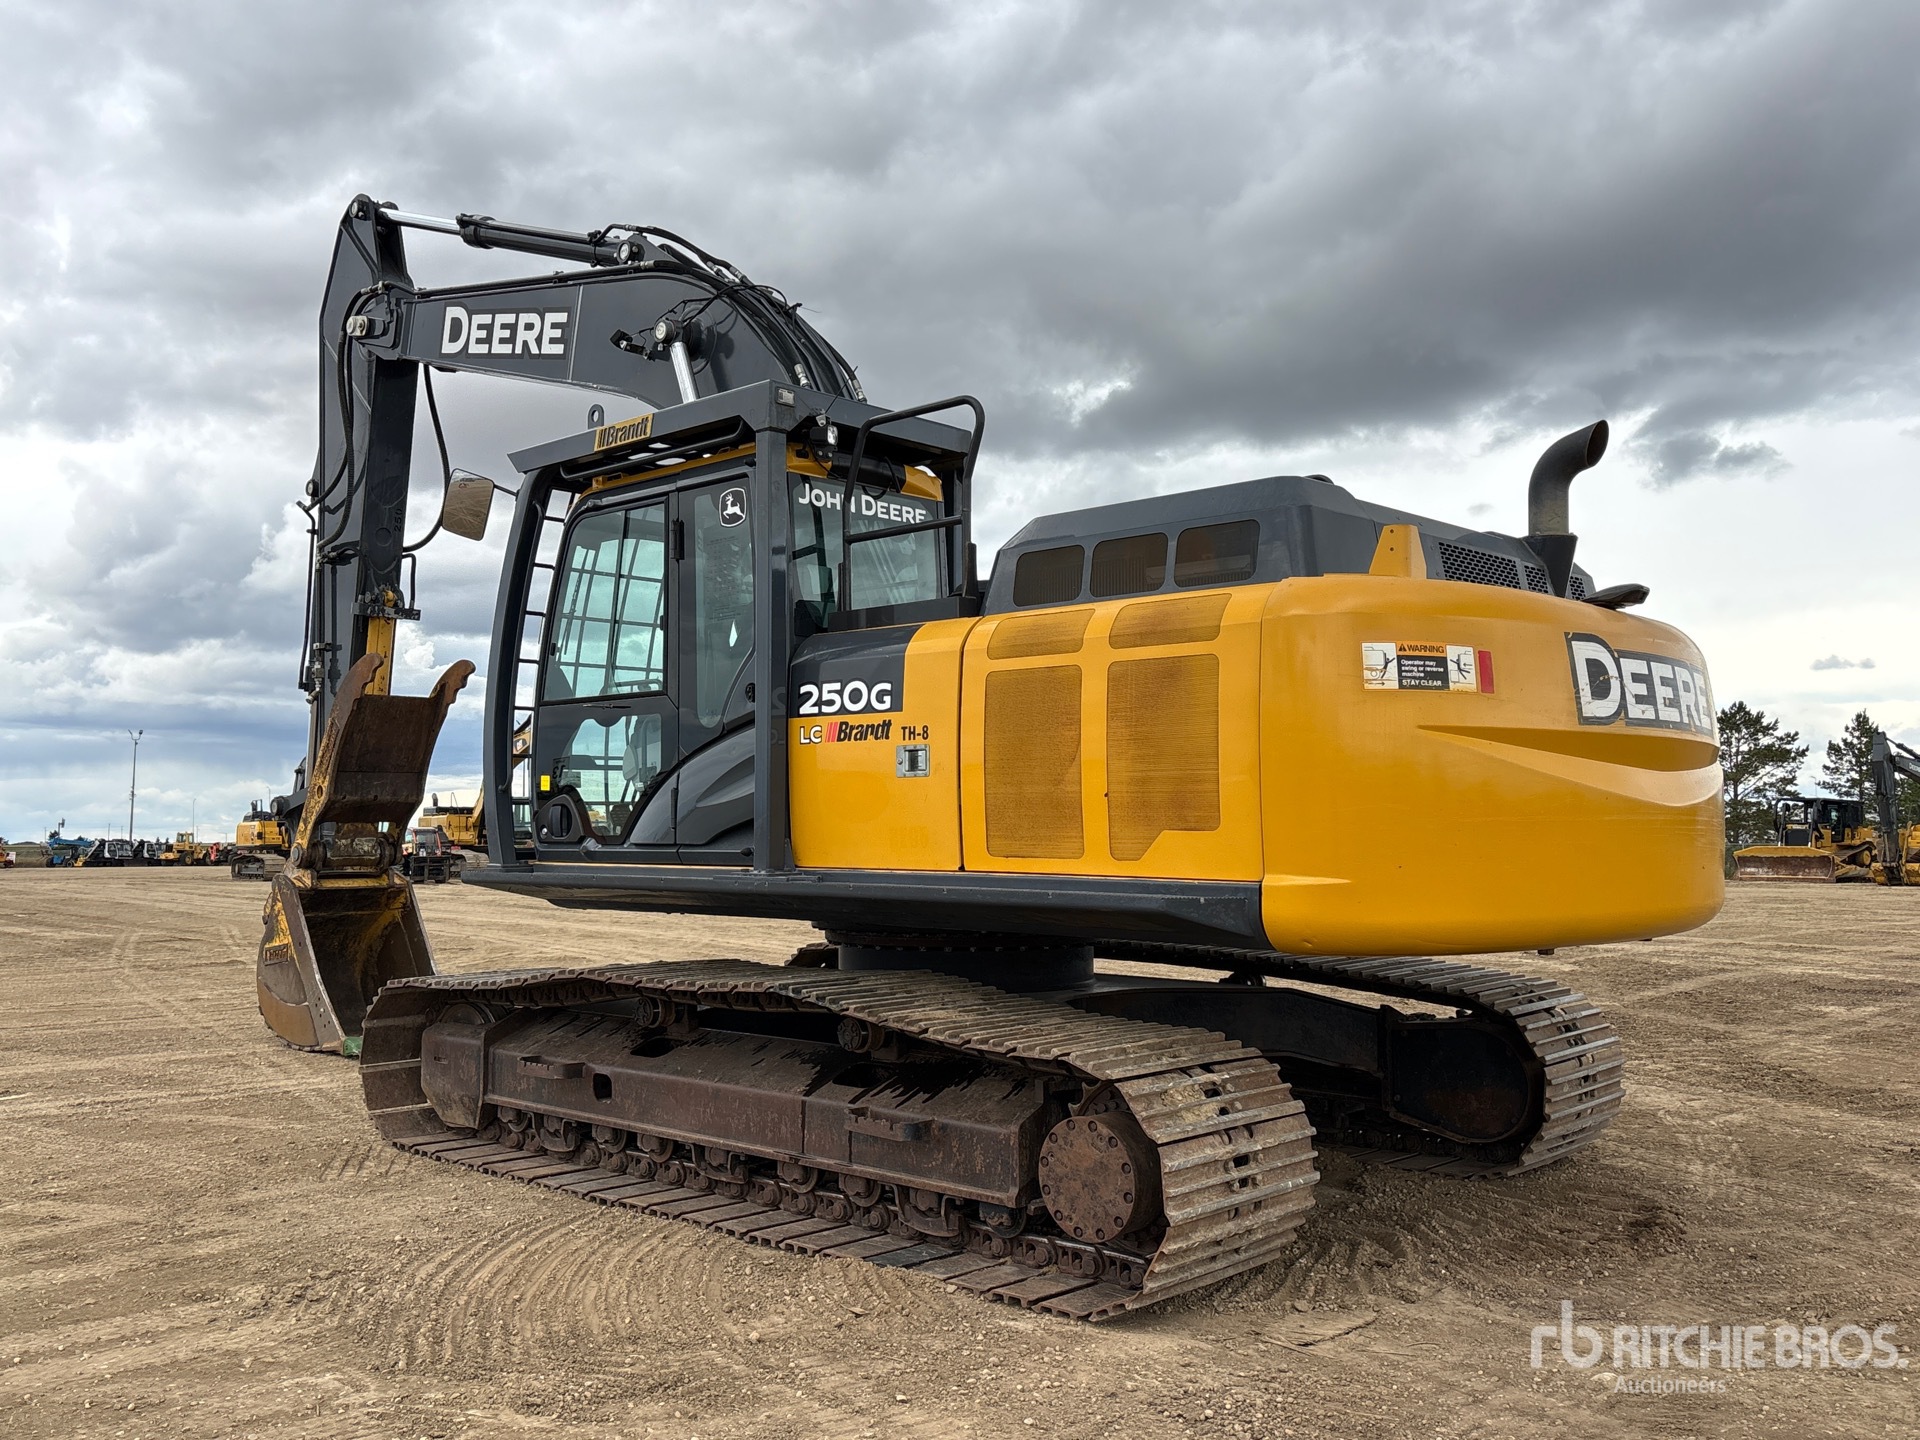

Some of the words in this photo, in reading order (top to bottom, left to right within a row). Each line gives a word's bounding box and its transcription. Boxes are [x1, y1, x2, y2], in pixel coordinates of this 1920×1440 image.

[441, 306, 568, 354] DEERE
[605, 416, 650, 447] Brandt
[861, 494, 927, 524] DEERE
[1406, 644, 1445, 654] WARNING
[799, 680, 892, 714] 250G
[1571, 640, 1712, 730] DEERE
[800, 725, 822, 744] LC
[836, 719, 892, 742] Brandt
[901, 725, 929, 741] TH-8
